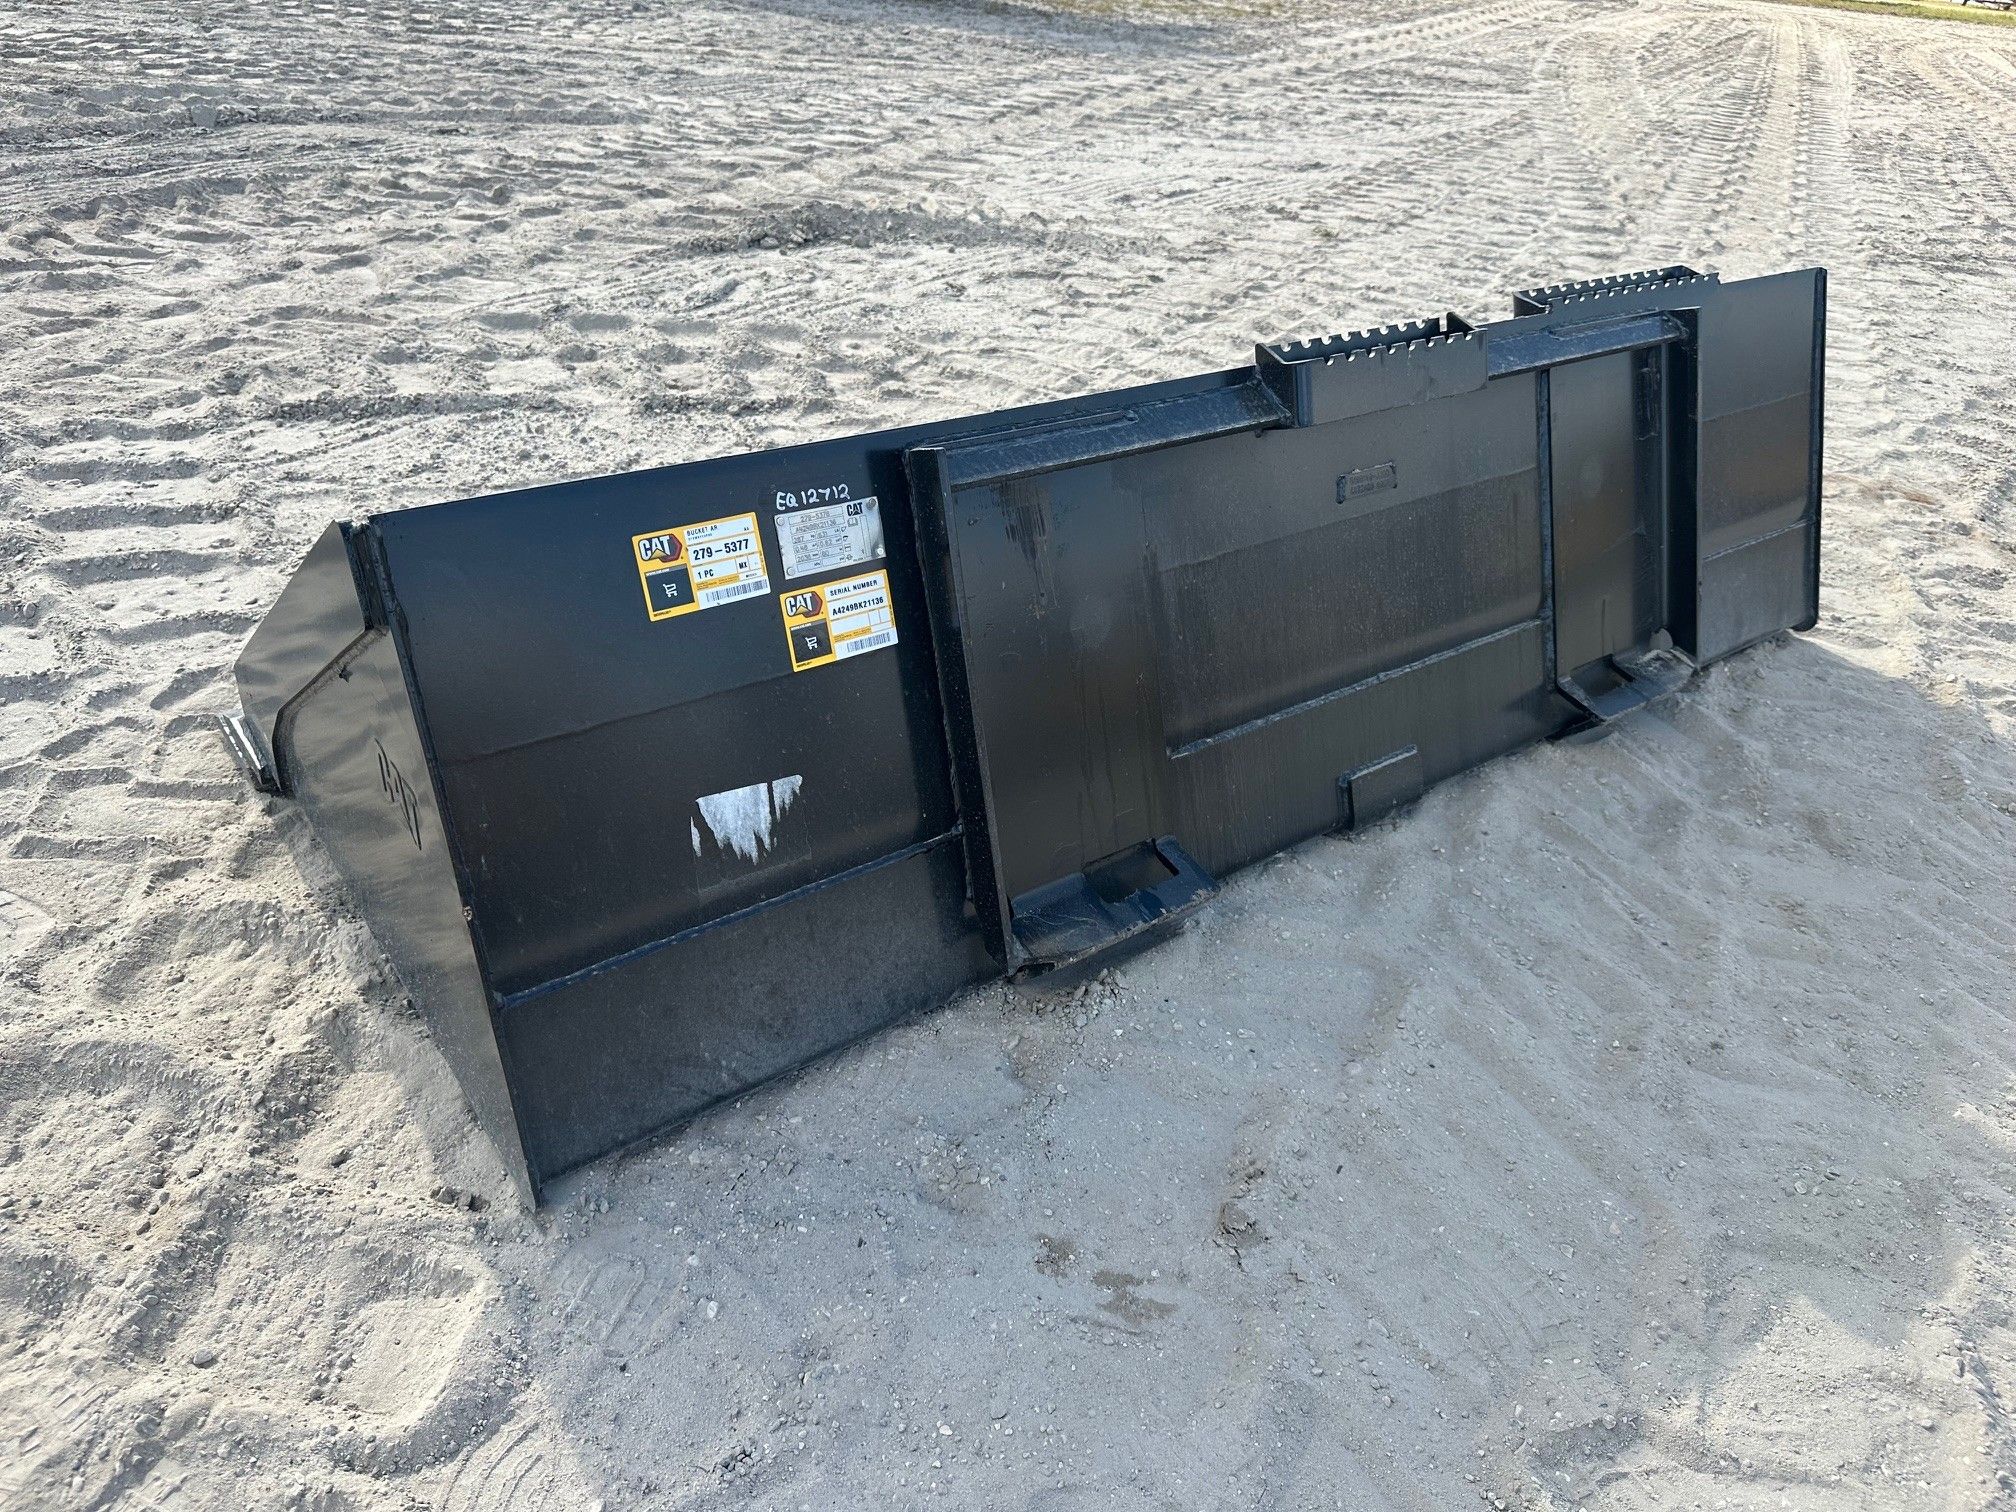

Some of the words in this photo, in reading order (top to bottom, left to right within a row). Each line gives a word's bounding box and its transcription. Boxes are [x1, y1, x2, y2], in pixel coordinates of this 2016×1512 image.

[801, 484, 850, 505] 12712
[846, 502, 863, 517] CAT
[686, 527, 707, 537] BUCKET
[639, 535, 671, 561] CAT
[697, 571, 702, 579] 1
[704, 569, 714, 578] PC
[830, 587, 851, 597] SERIAL
[853, 579, 878, 591] NUMBER
[785, 593, 813, 617] CAT
[832, 596, 884, 616] A4249BK21136
